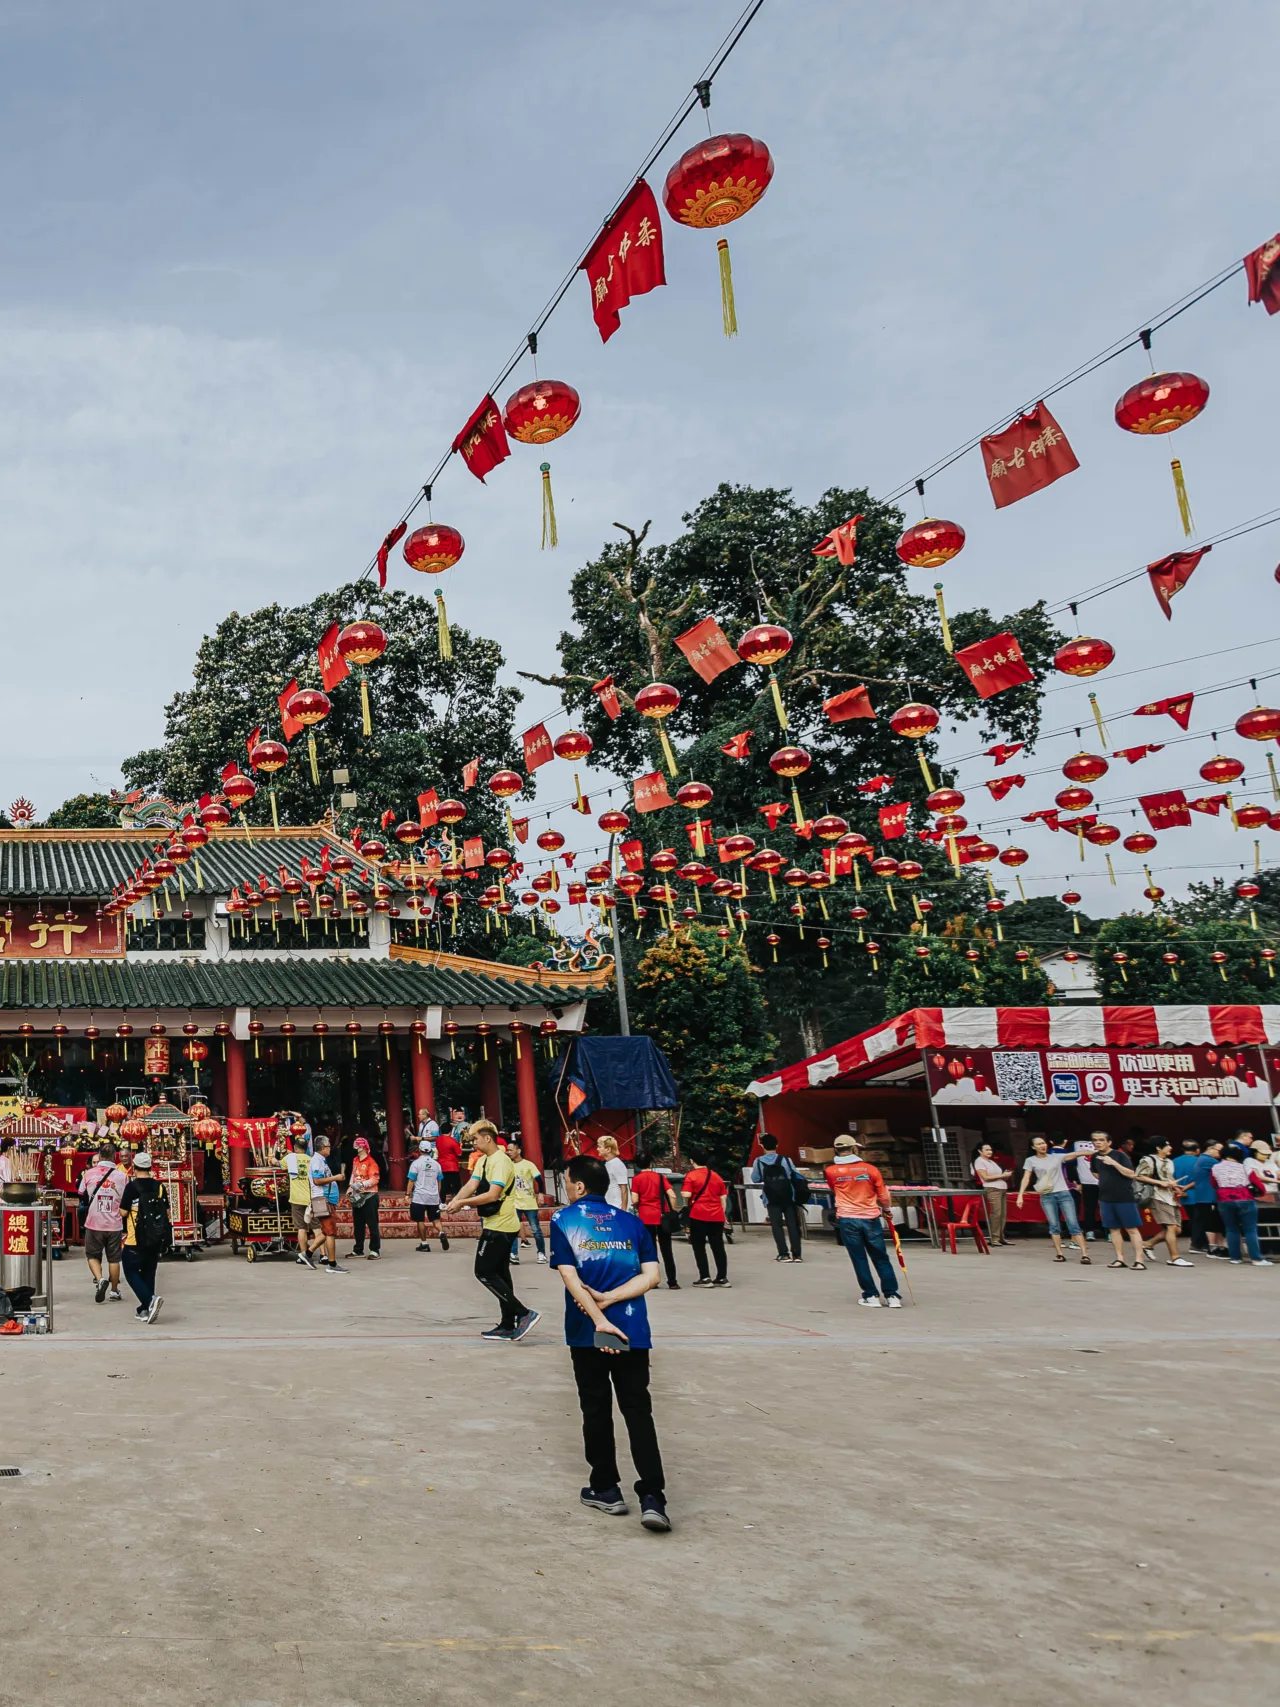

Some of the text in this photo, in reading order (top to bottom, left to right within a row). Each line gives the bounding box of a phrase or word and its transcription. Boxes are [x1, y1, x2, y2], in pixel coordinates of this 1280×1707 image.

[1117, 1054, 1196, 1072] 欢迎使用
[1121, 1077, 1239, 1097] 电子钱包添油
